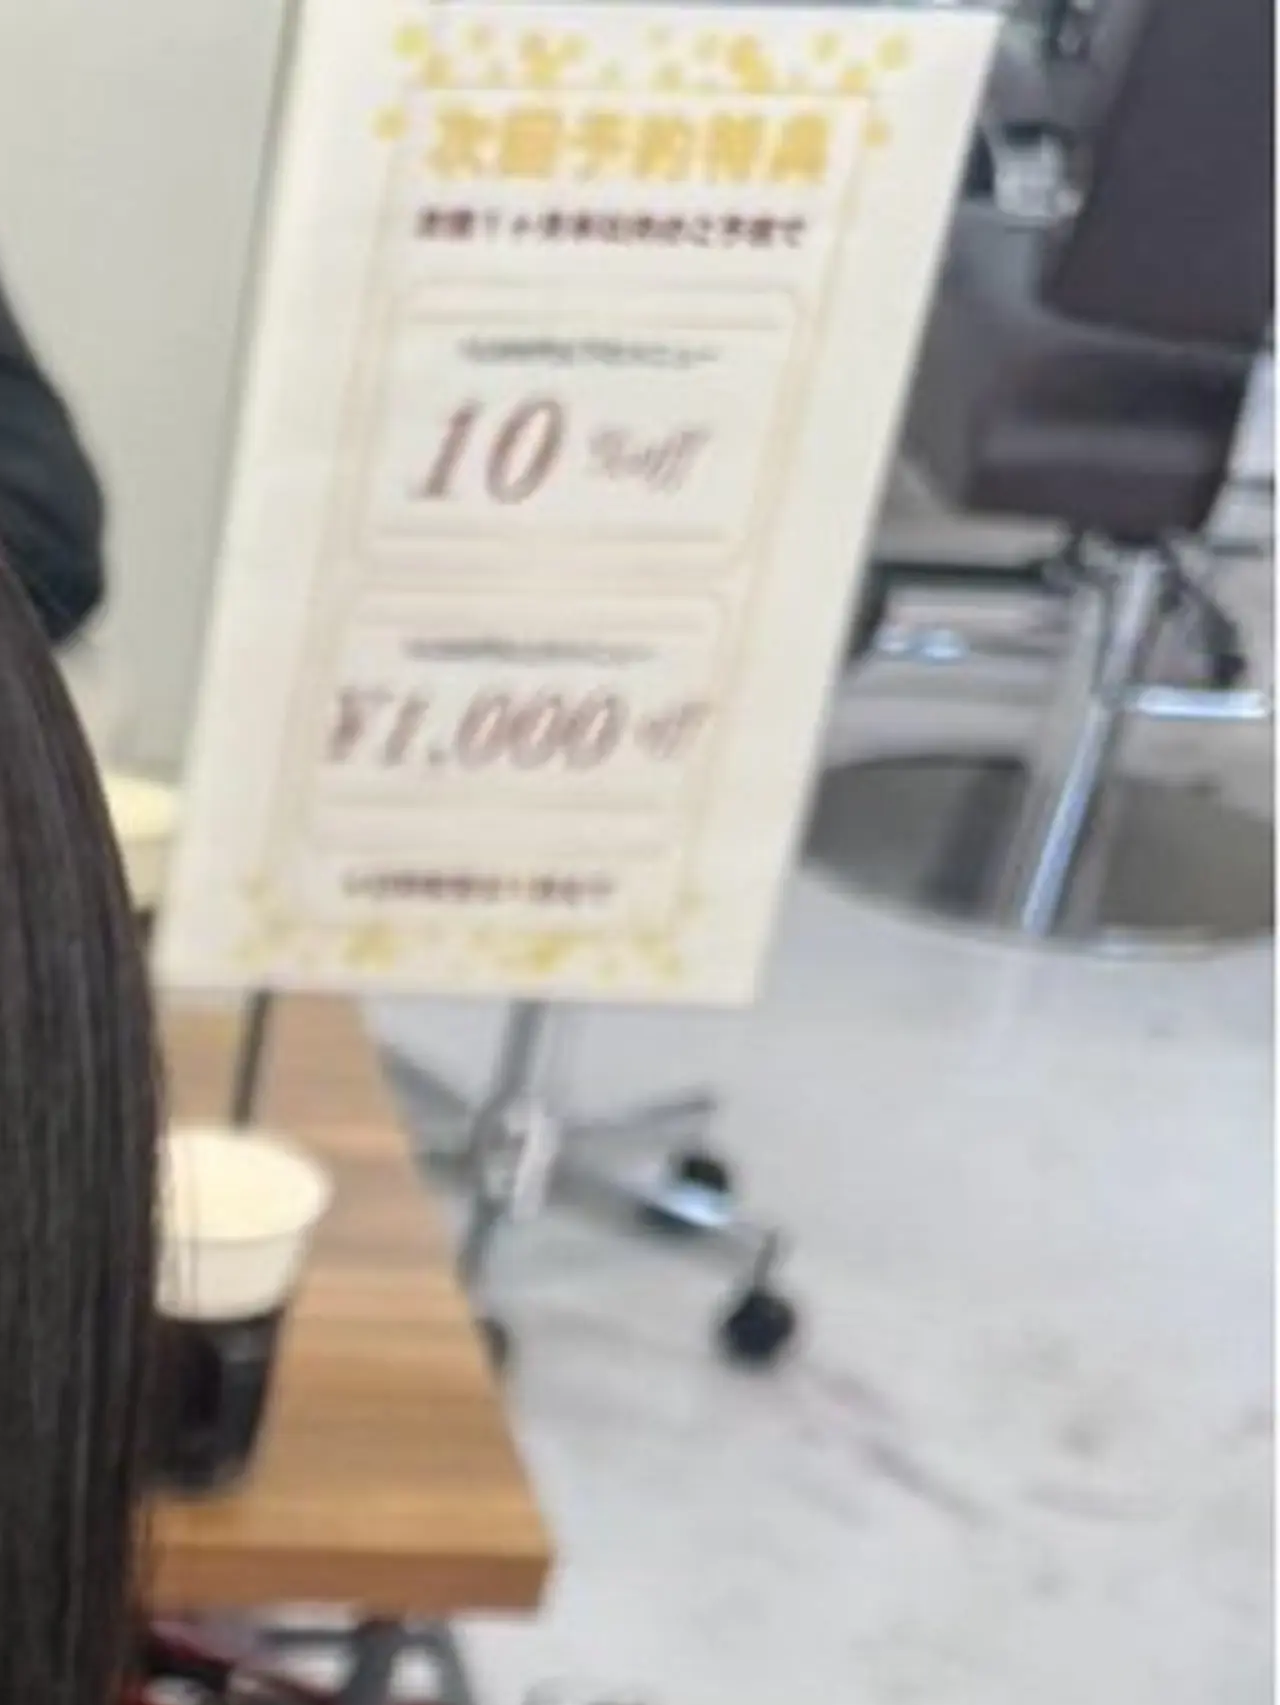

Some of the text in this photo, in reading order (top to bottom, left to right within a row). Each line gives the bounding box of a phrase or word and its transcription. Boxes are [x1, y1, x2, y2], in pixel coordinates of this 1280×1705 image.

[426, 108, 828, 184] 次回予約特典
[408, 394, 564, 504] 10
